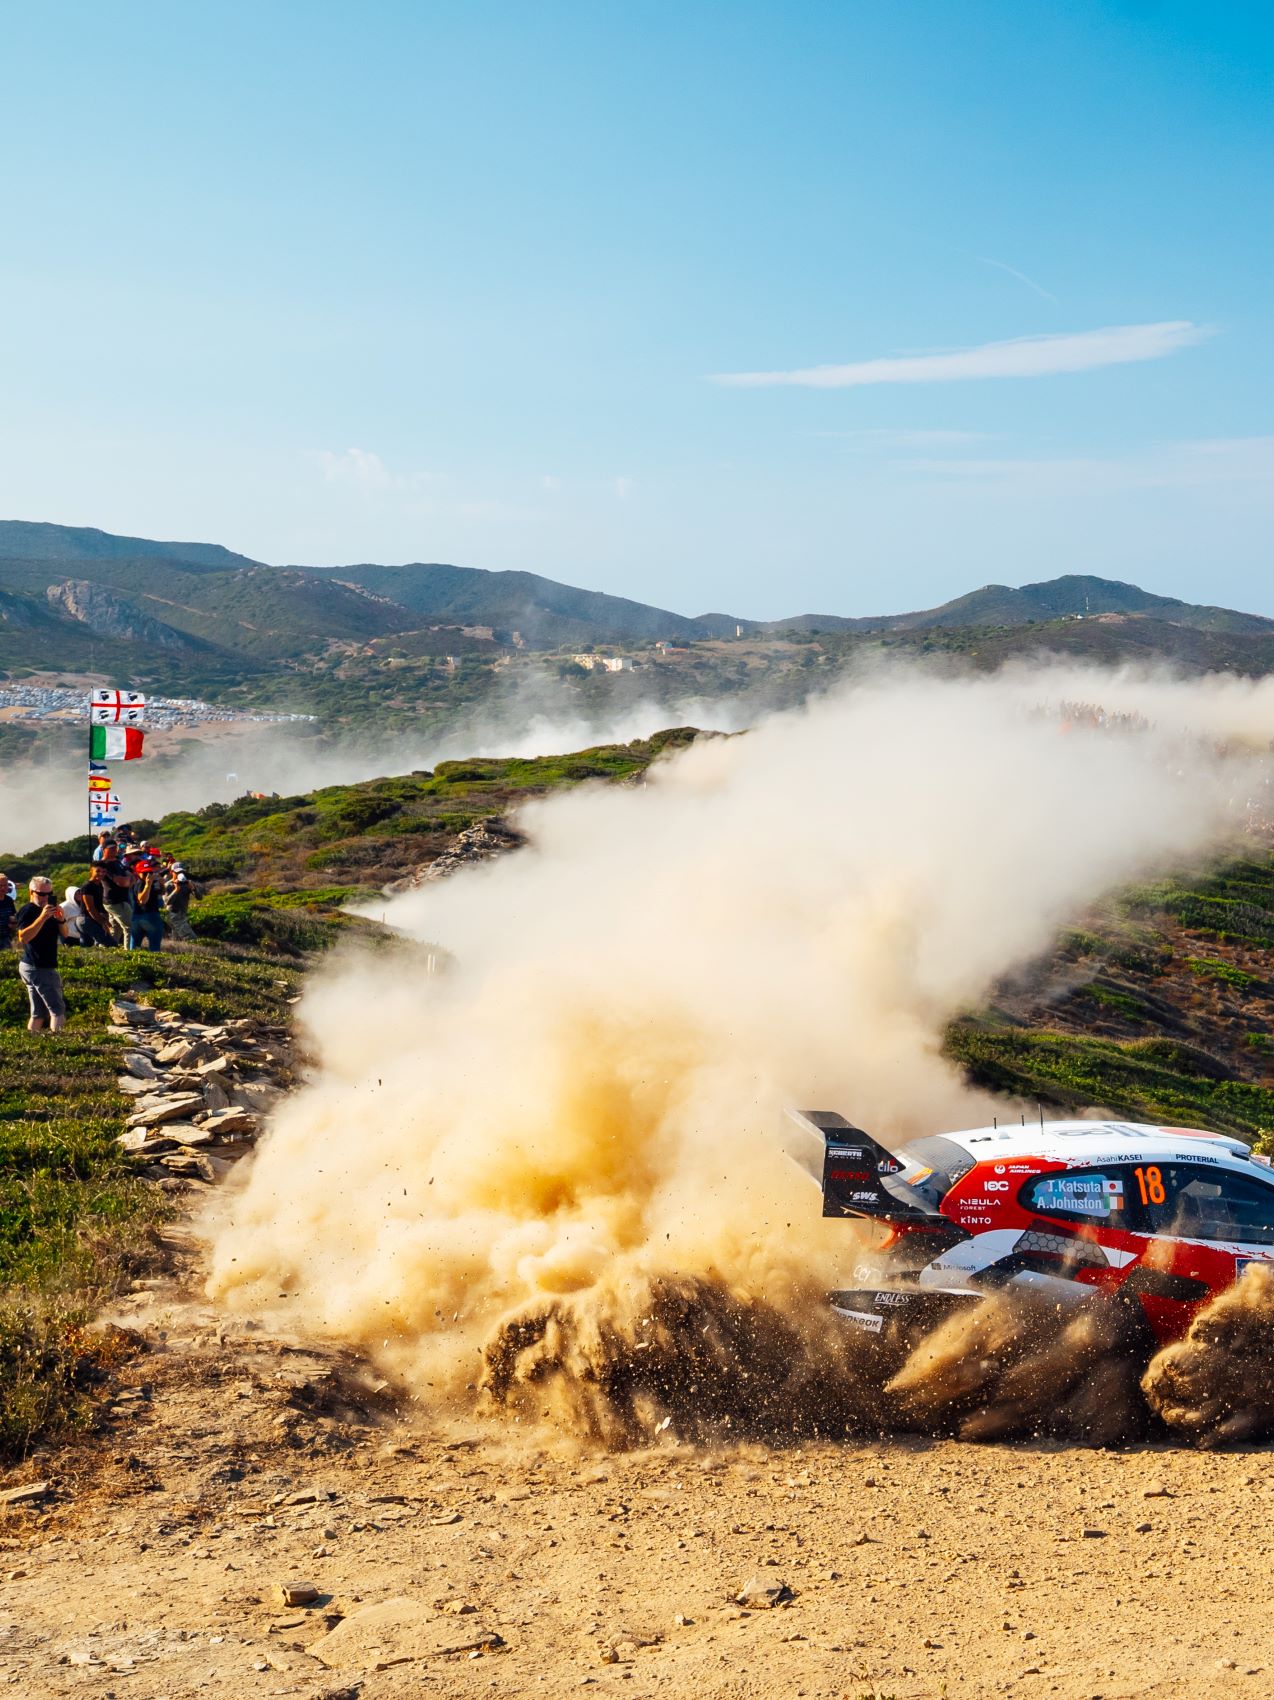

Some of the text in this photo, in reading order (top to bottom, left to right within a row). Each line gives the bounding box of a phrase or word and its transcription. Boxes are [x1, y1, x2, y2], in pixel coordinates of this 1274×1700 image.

[1175, 1153, 1219, 1164] PROTERIAL
[1134, 1166, 1166, 1205] 18
[852, 1191, 879, 1201] SWS
[874, 1292, 911, 1304] ENDLESS
